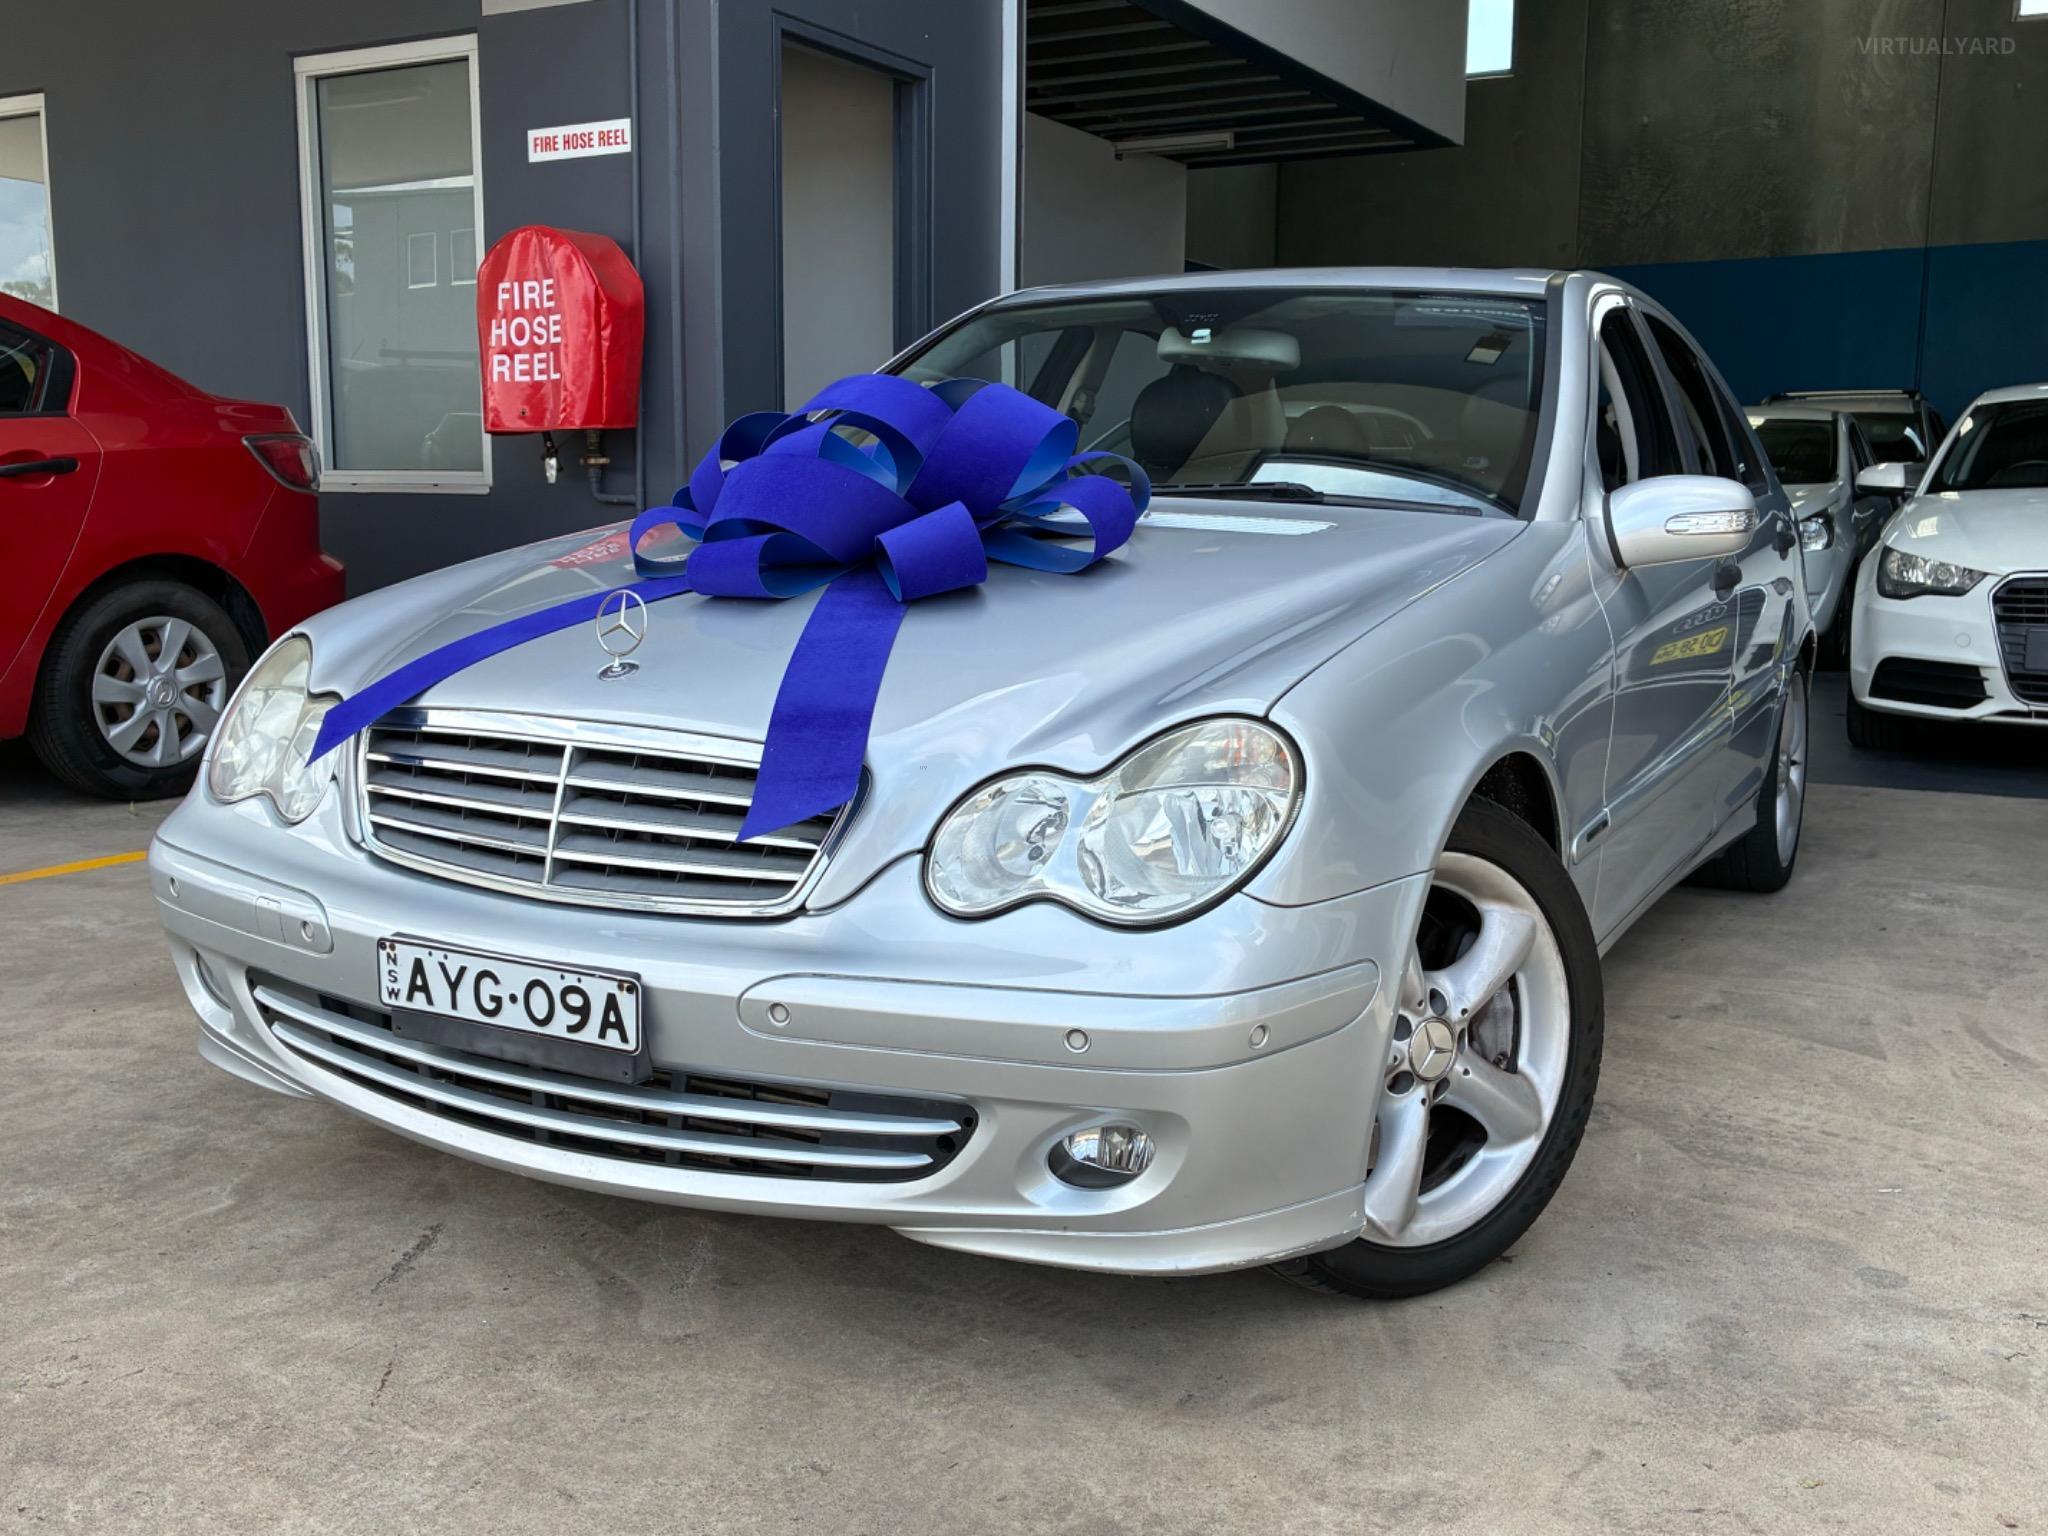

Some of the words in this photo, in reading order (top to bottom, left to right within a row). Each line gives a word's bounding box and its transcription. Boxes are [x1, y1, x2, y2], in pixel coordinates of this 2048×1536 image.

[533, 135, 559, 153] FIRE
[563, 131, 595, 151] HOSE
[598, 128, 628, 147] REEL
[498, 279, 555, 310] FIRE
[491, 314, 562, 347] HOSE
[493, 352, 561, 383] REEL
